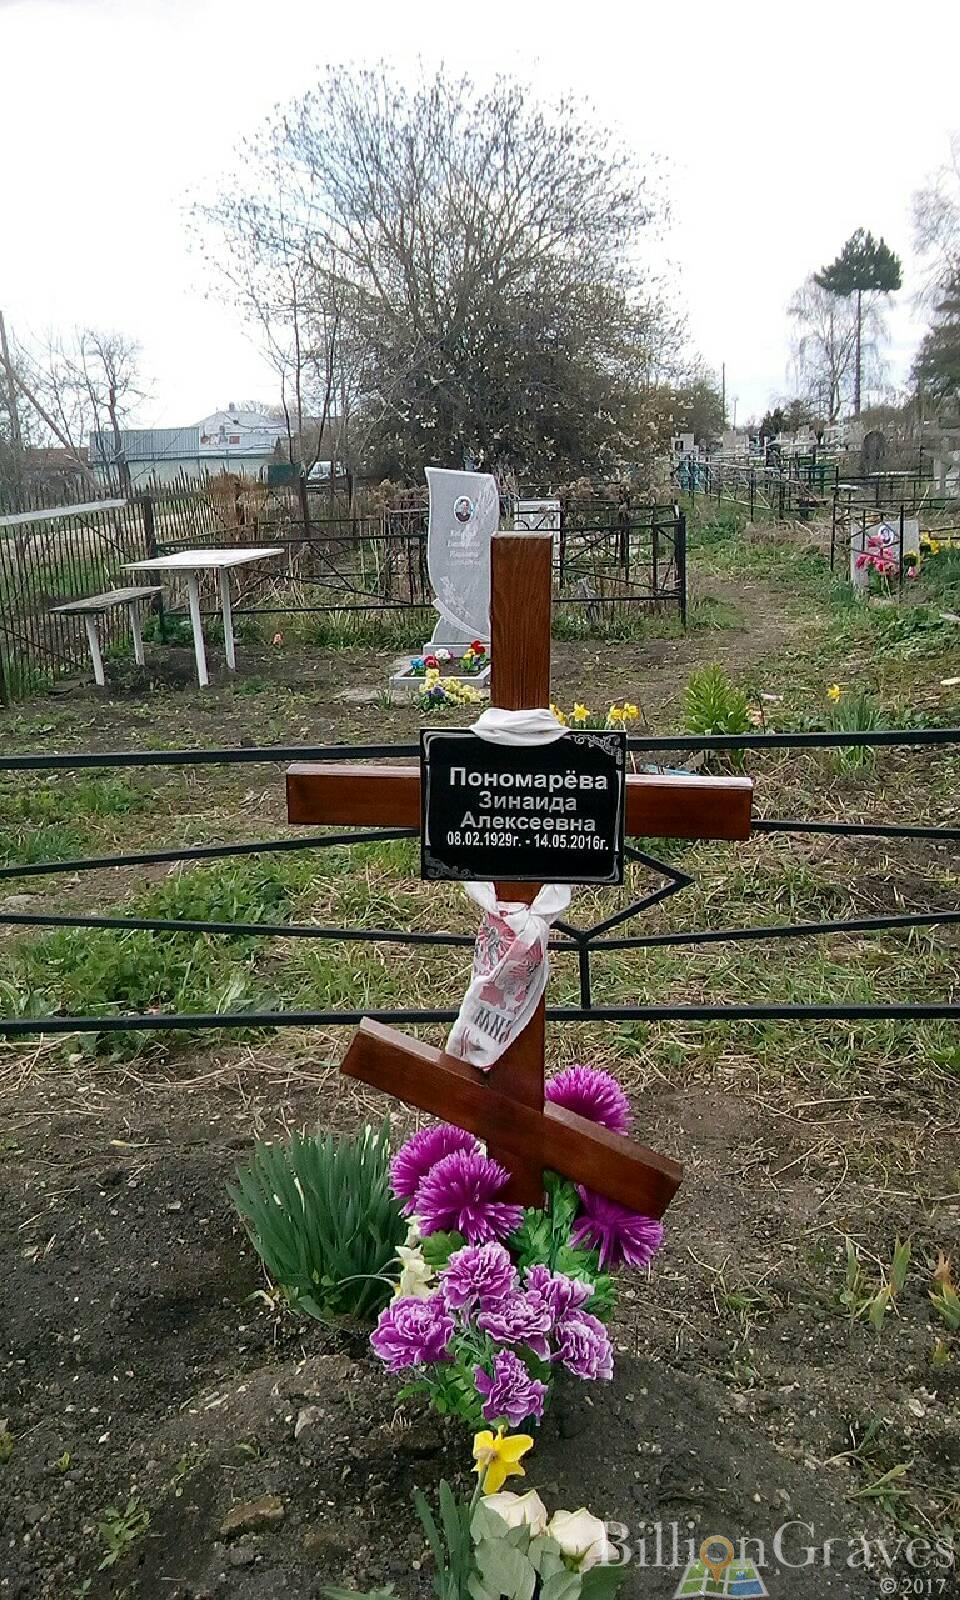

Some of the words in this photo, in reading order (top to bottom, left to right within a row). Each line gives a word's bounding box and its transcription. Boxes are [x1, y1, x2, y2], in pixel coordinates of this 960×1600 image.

[449, 767, 608, 792] Пономарёва
[479, 791, 577, 813] Зинаида
[460, 811, 596, 831] Алексеевна
[447, 831, 522, 847] 08.02.1929г.
[534, 834, 609, 850] 14.05.2016г.
